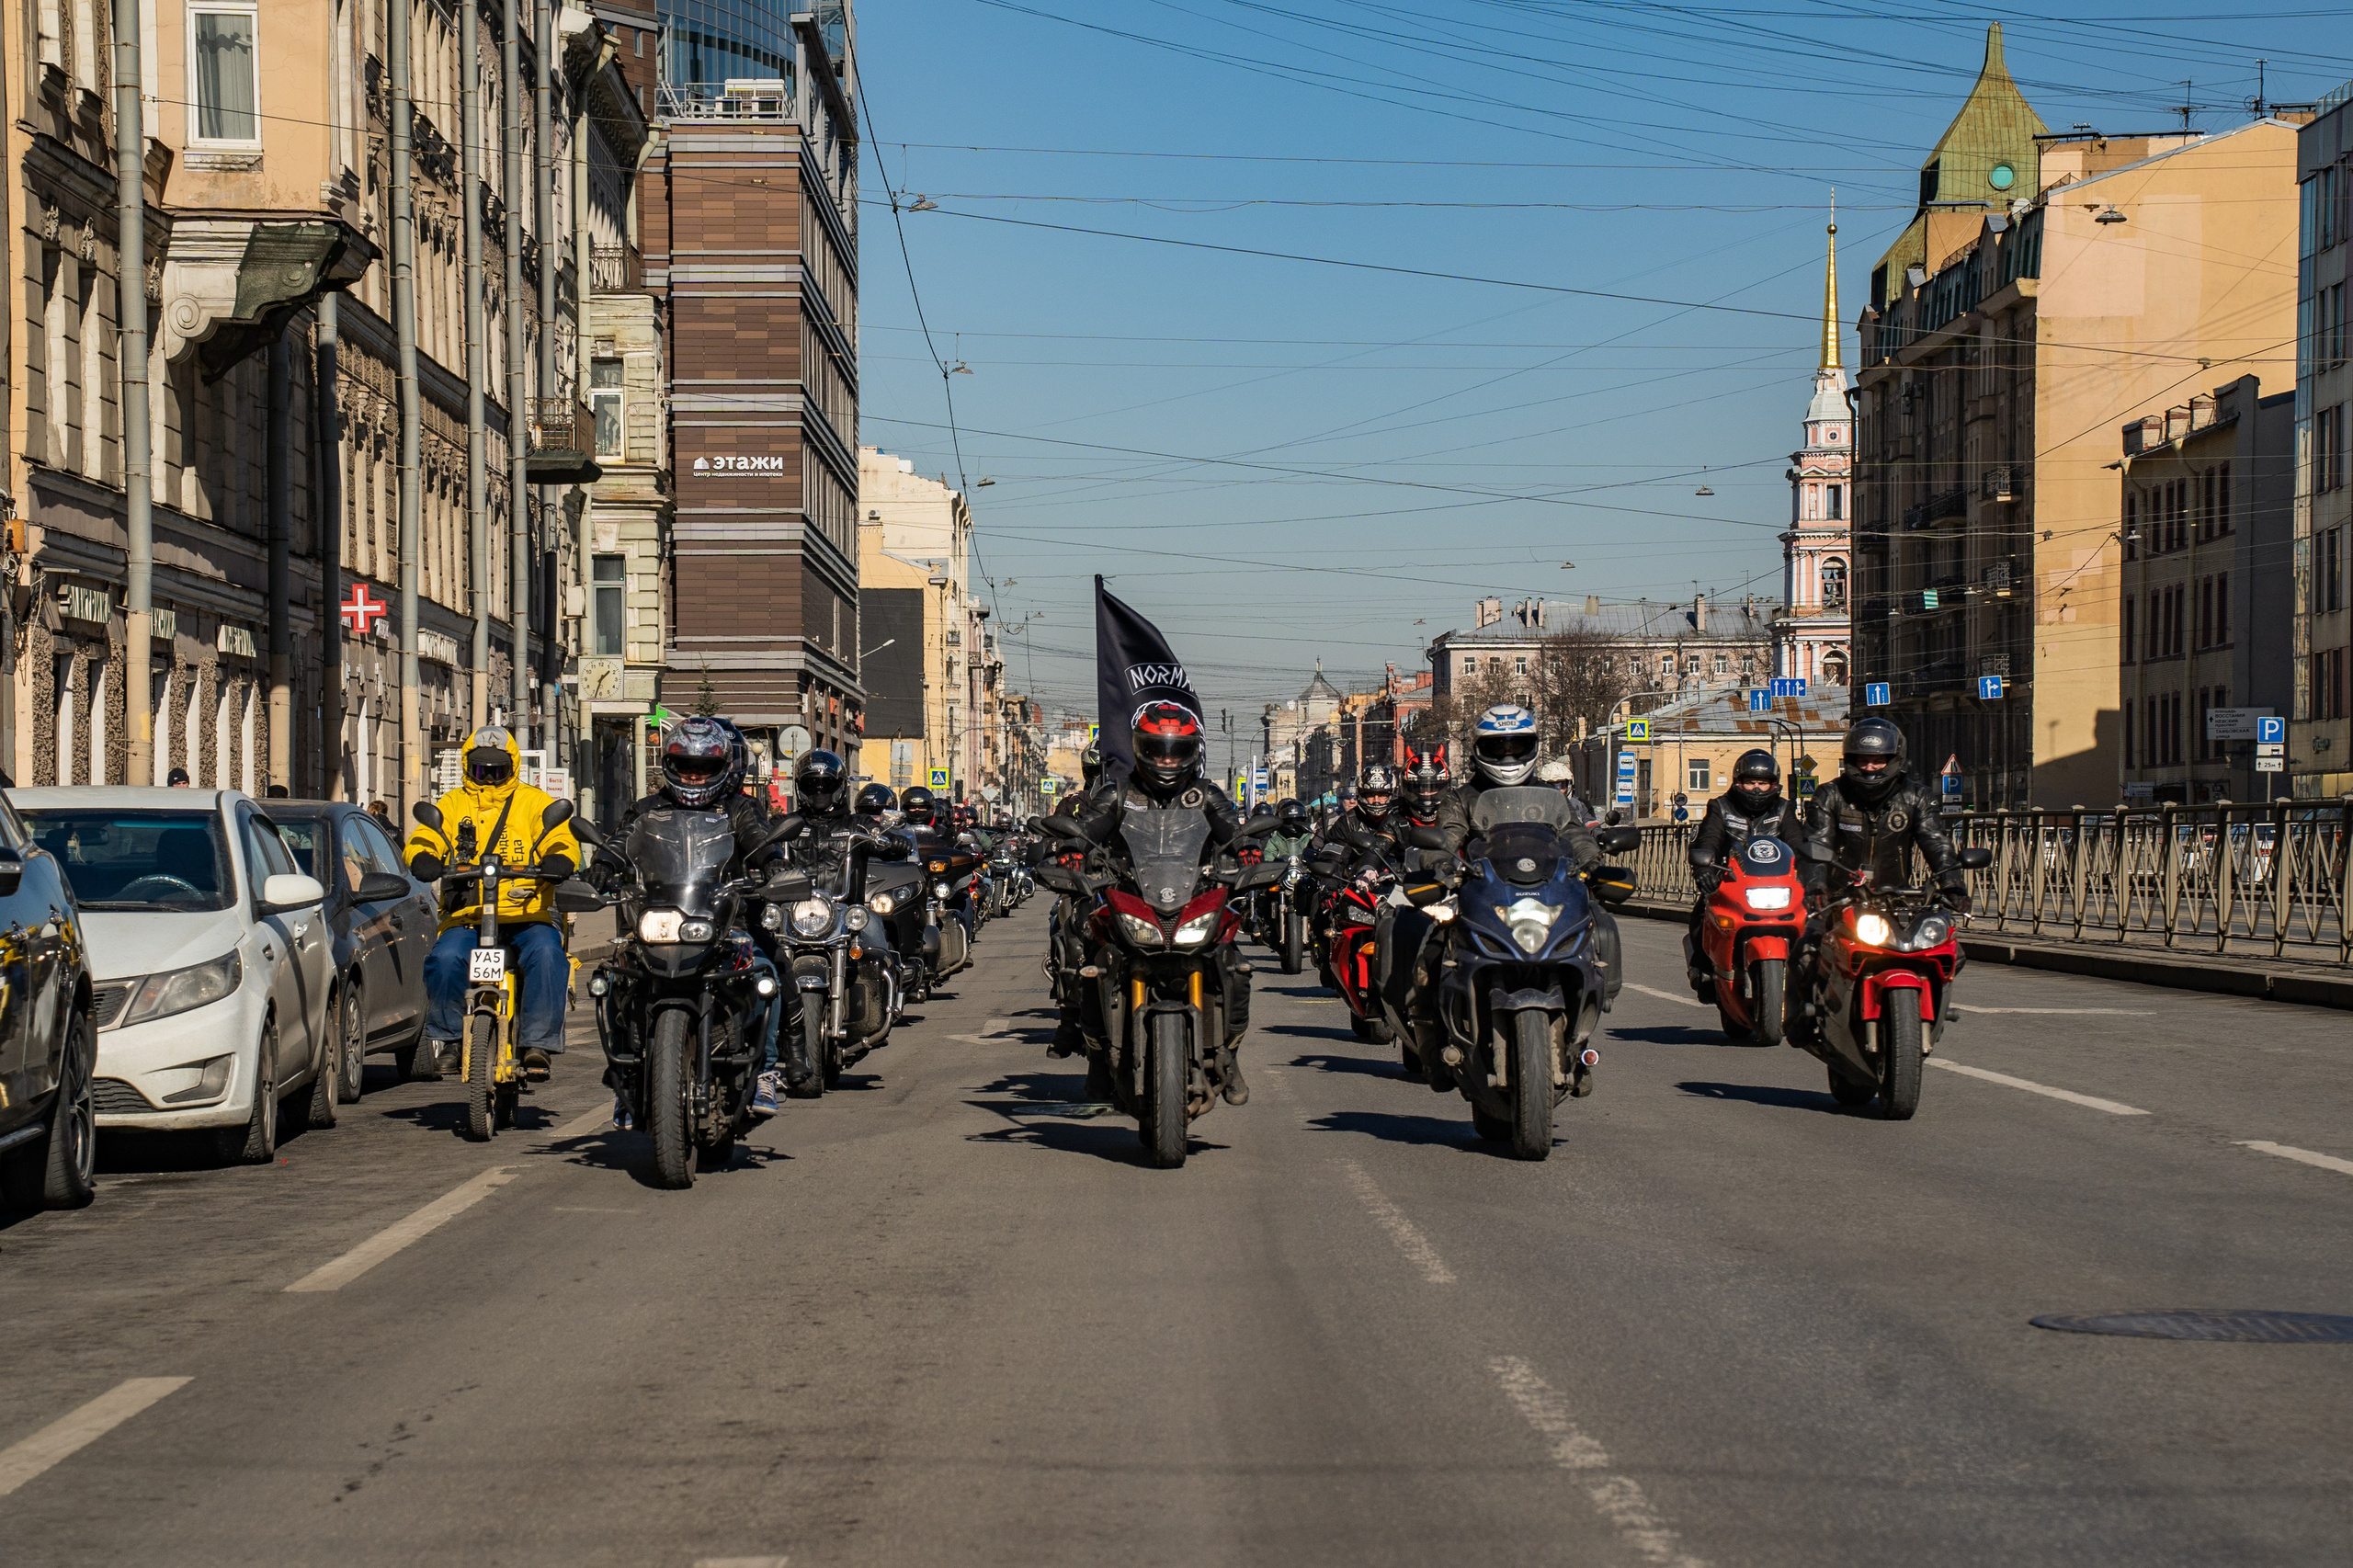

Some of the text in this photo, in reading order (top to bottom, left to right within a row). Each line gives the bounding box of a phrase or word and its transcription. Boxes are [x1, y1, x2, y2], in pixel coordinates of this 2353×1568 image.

[712, 456, 783, 470] этажи
[1130, 665, 1194, 693] NORMA
[512, 839, 525, 863] Еда
